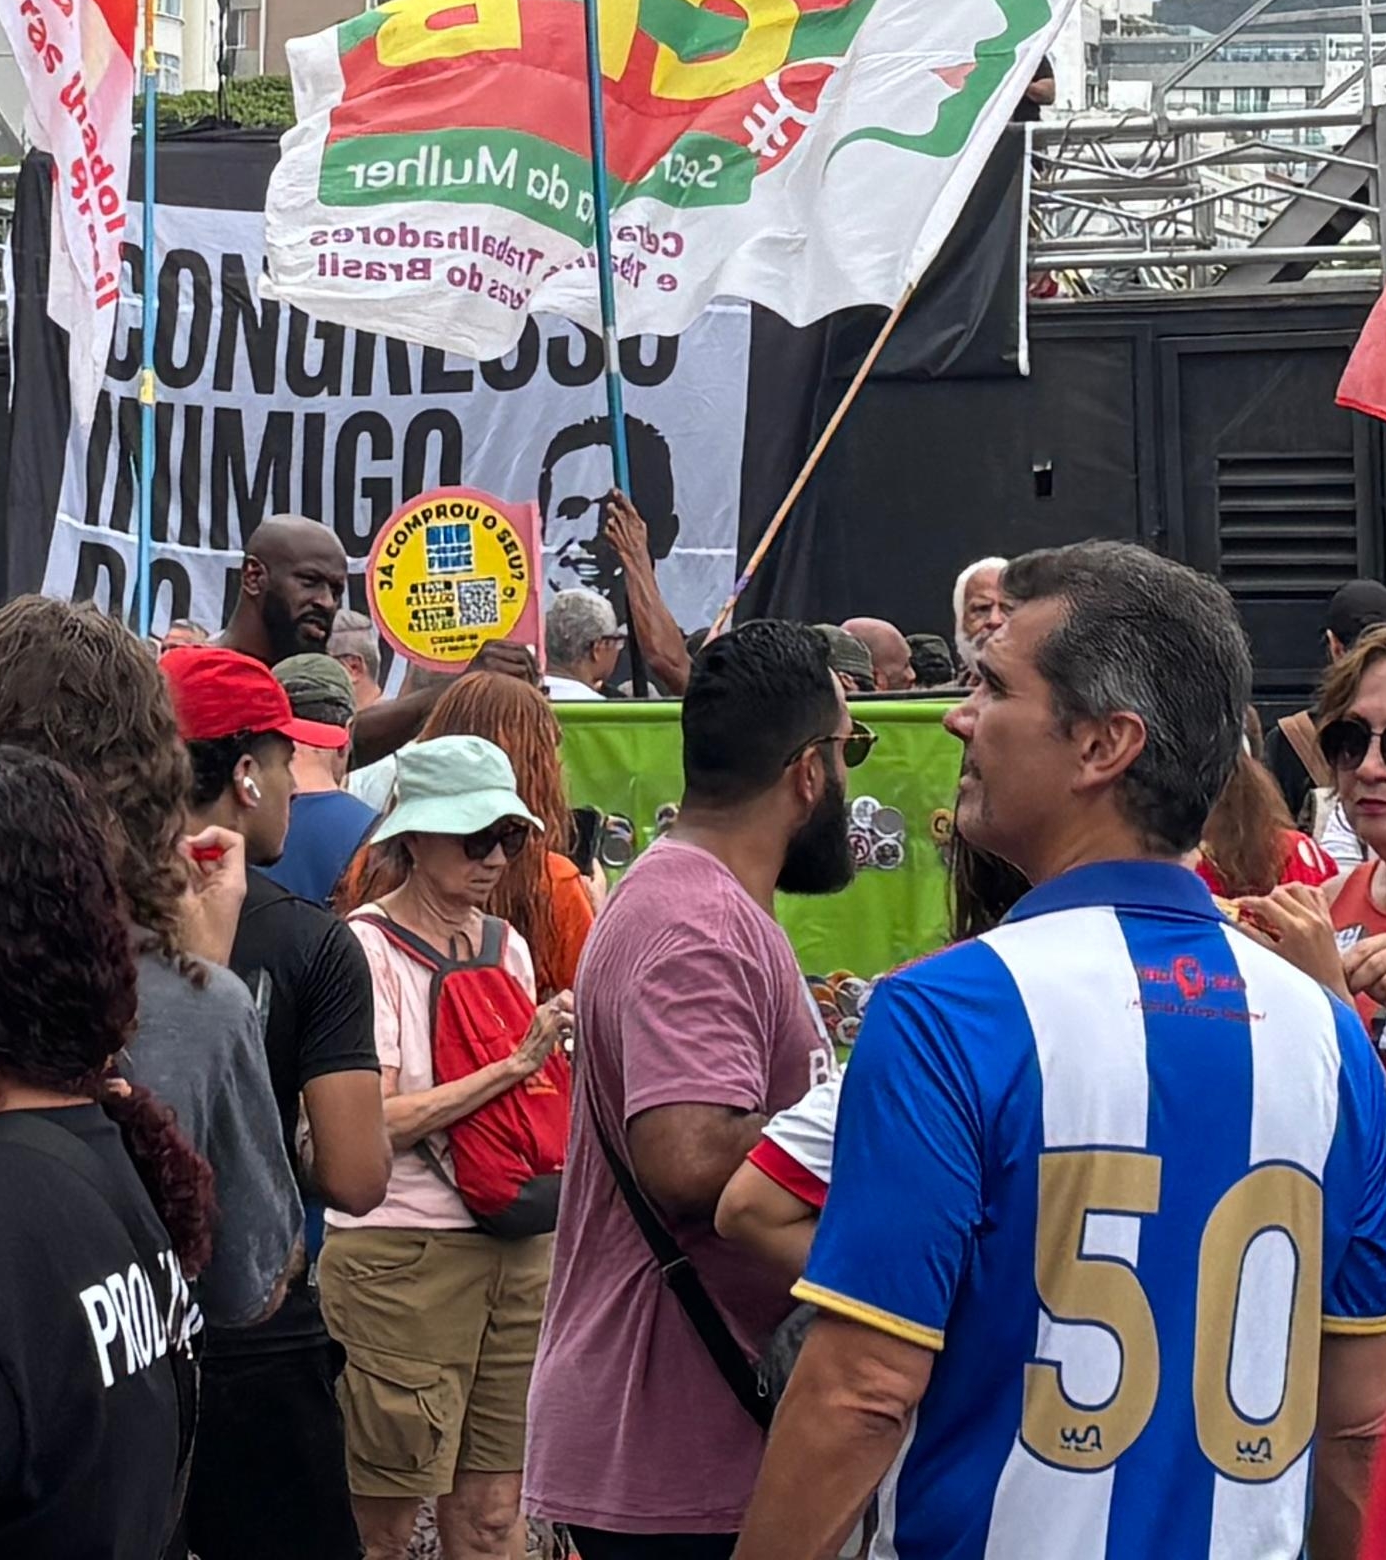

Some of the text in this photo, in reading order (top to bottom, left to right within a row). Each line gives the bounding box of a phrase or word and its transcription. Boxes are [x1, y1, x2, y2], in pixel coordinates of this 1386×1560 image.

[385, 503, 480, 559] COMPROU
[482, 515, 498, 530] O
[379, 564, 395, 591] JÁ
[496, 529, 525, 582] SEU?
[1020, 1146, 1325, 1483] 50
